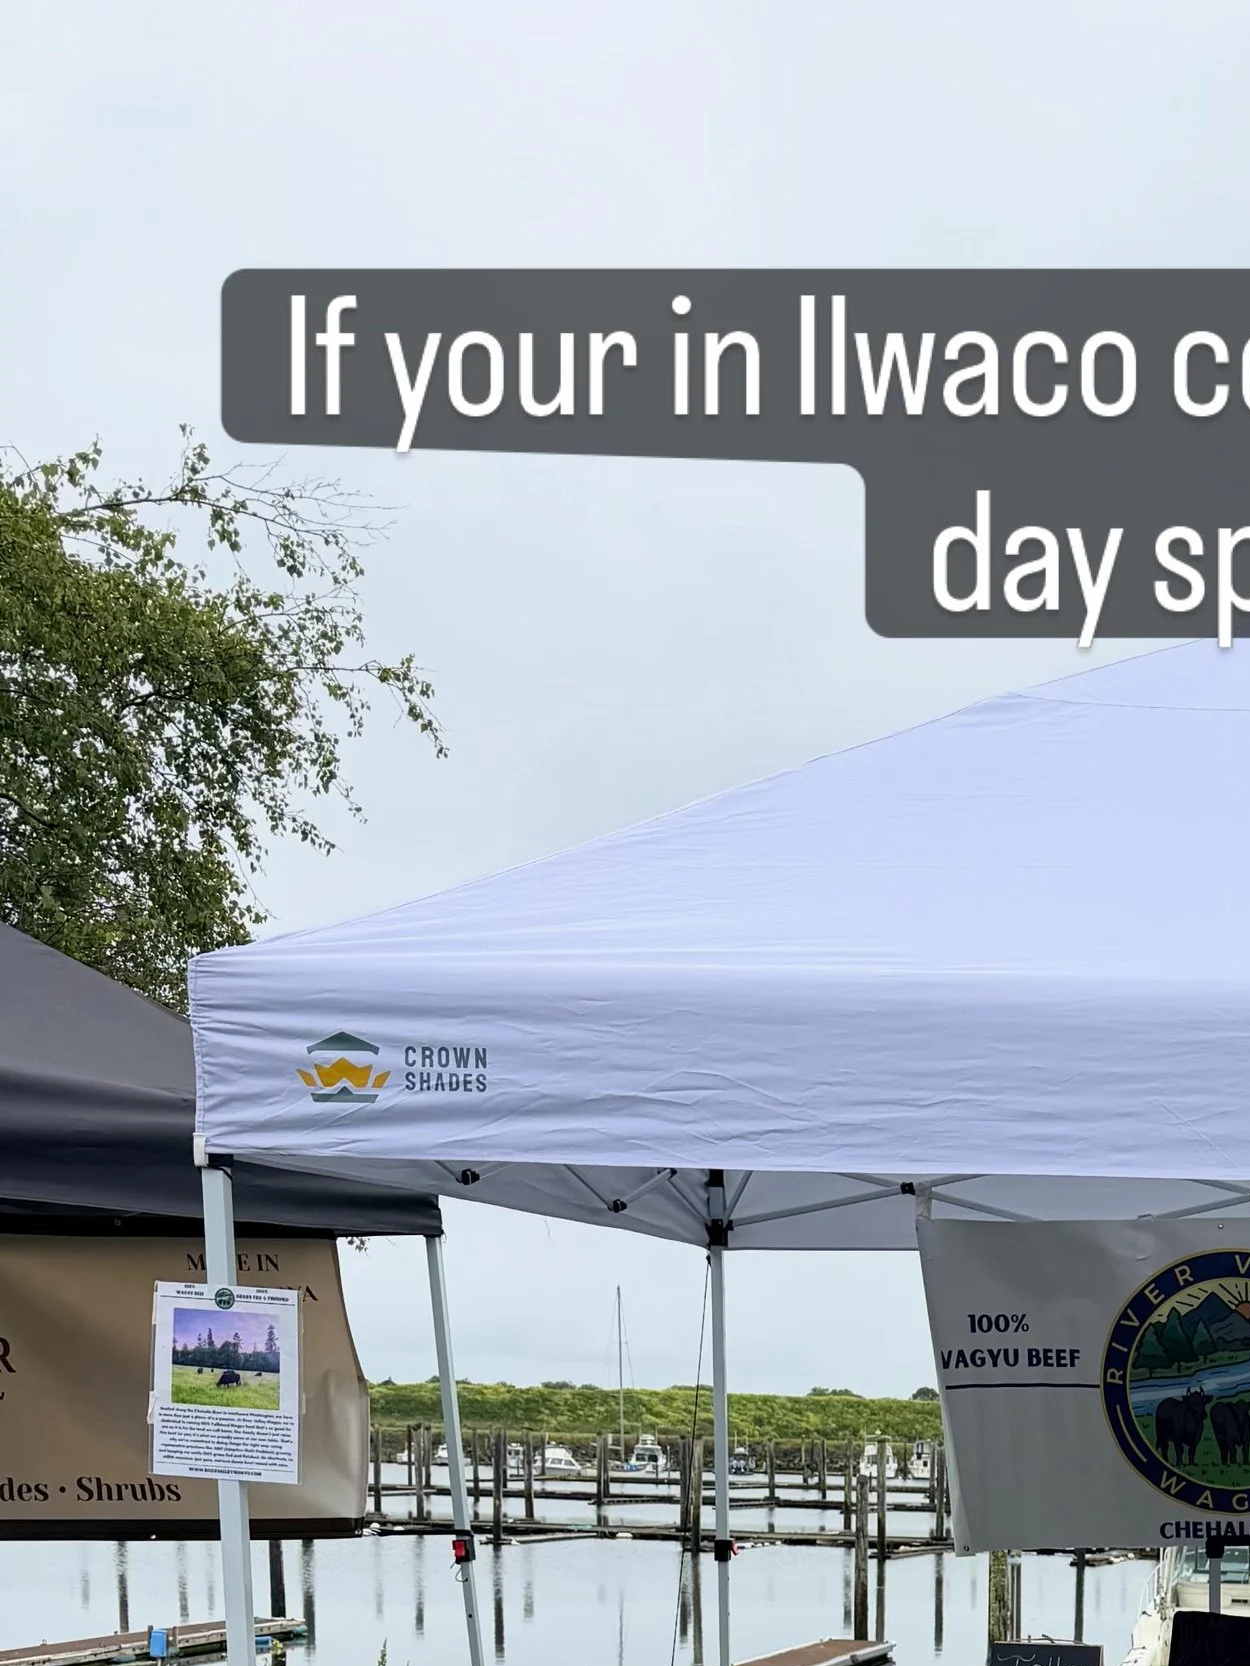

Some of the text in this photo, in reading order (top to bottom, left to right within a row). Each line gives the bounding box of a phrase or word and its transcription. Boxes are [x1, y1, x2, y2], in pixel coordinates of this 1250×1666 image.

[405, 1046, 487, 1069] CROWN
[405, 1072, 487, 1092] SHADES
[186, 1253, 280, 1272] ME IN
[968, 1313, 1030, 1333] 100%
[1106, 1264, 1195, 1385] RIVER
[1027, 1348, 1081, 1368] BEEF
[76, 1476, 182, 1502] Shrubs
